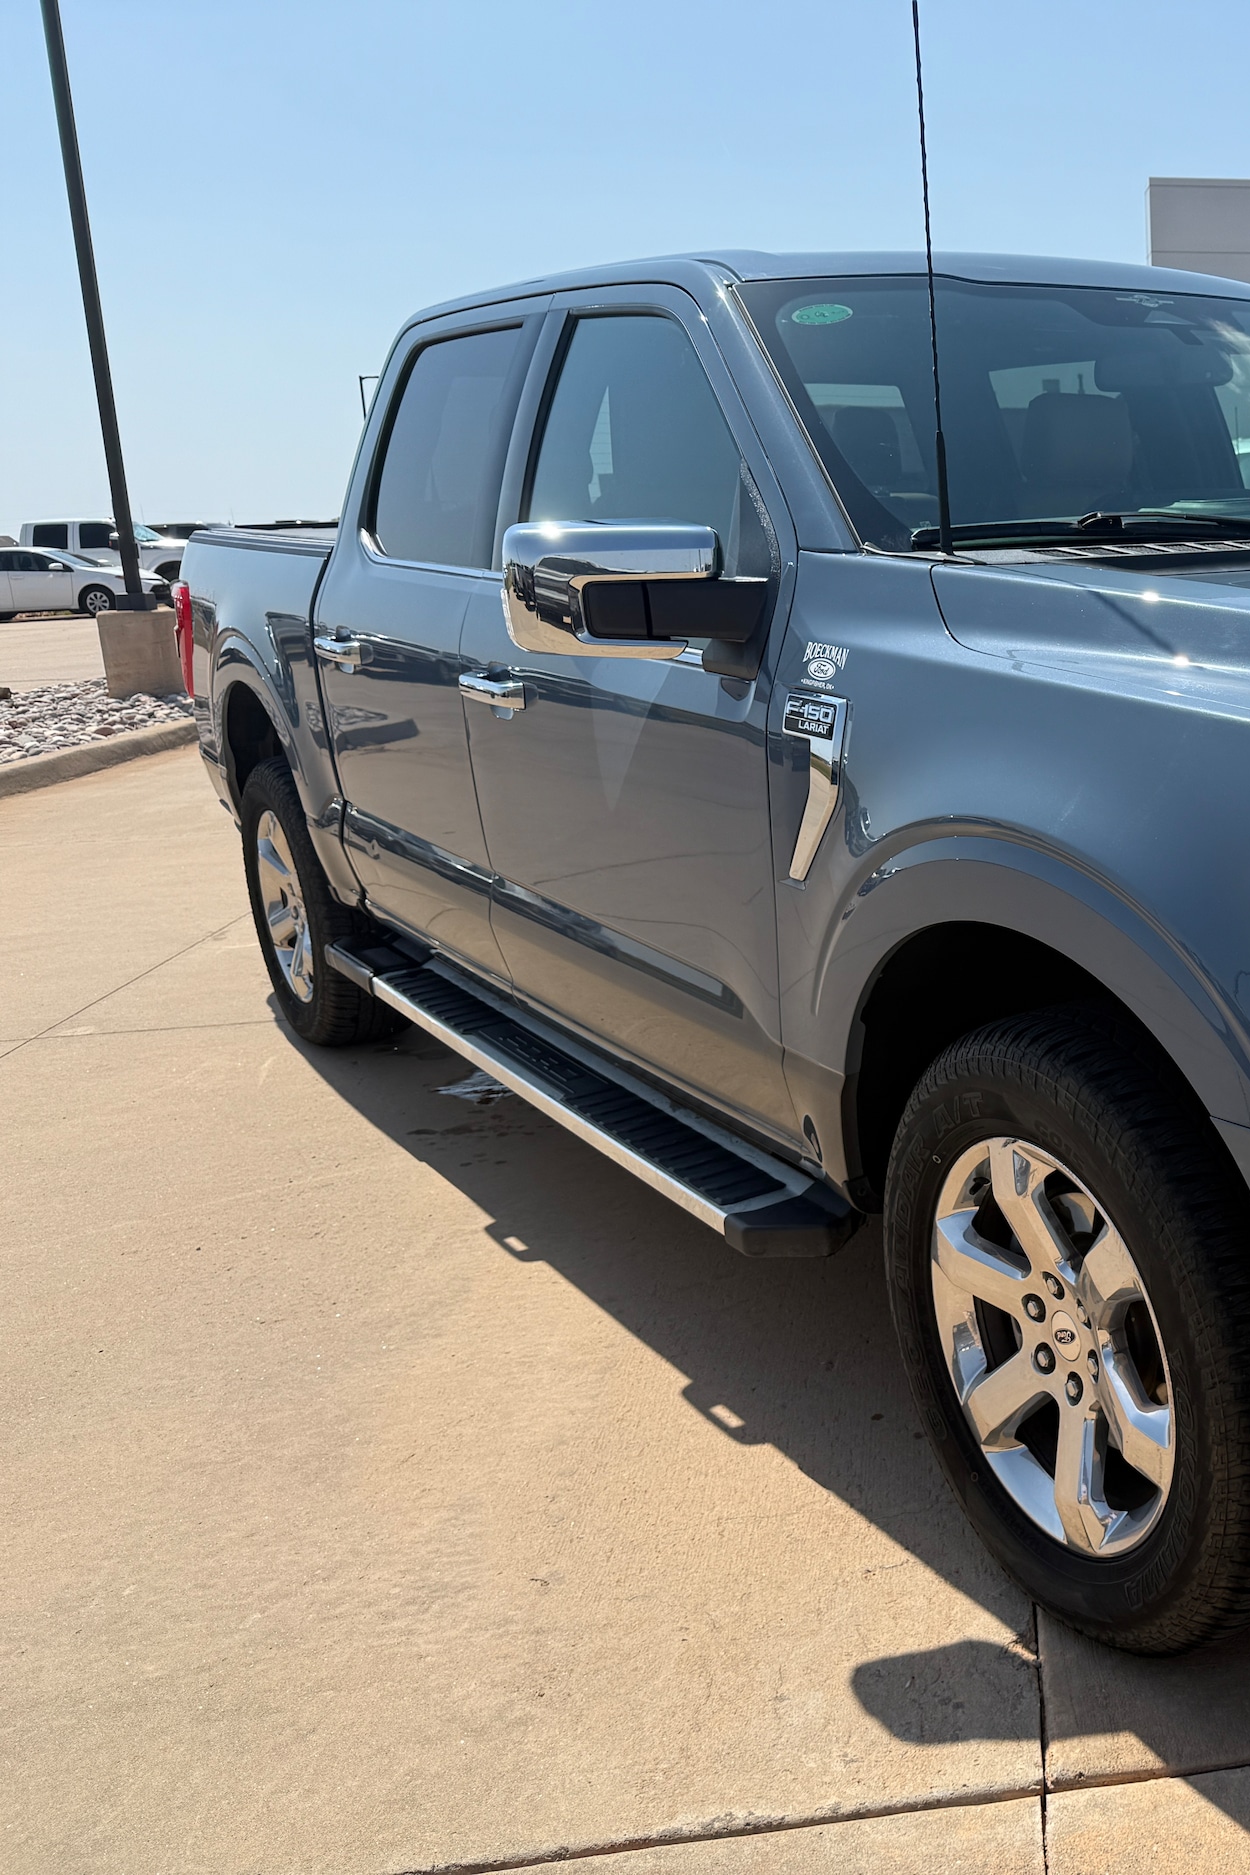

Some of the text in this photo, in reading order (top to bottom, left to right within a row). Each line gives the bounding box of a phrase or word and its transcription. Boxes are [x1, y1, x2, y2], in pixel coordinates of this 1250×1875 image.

[802, 641, 850, 670] BOECKMAN
[786, 700, 835, 724] F-150
[798, 720, 830, 734] LARIAT
[931, 1091, 984, 1138] A/T
[1124, 1349, 1197, 1608] YOKOHAMA
